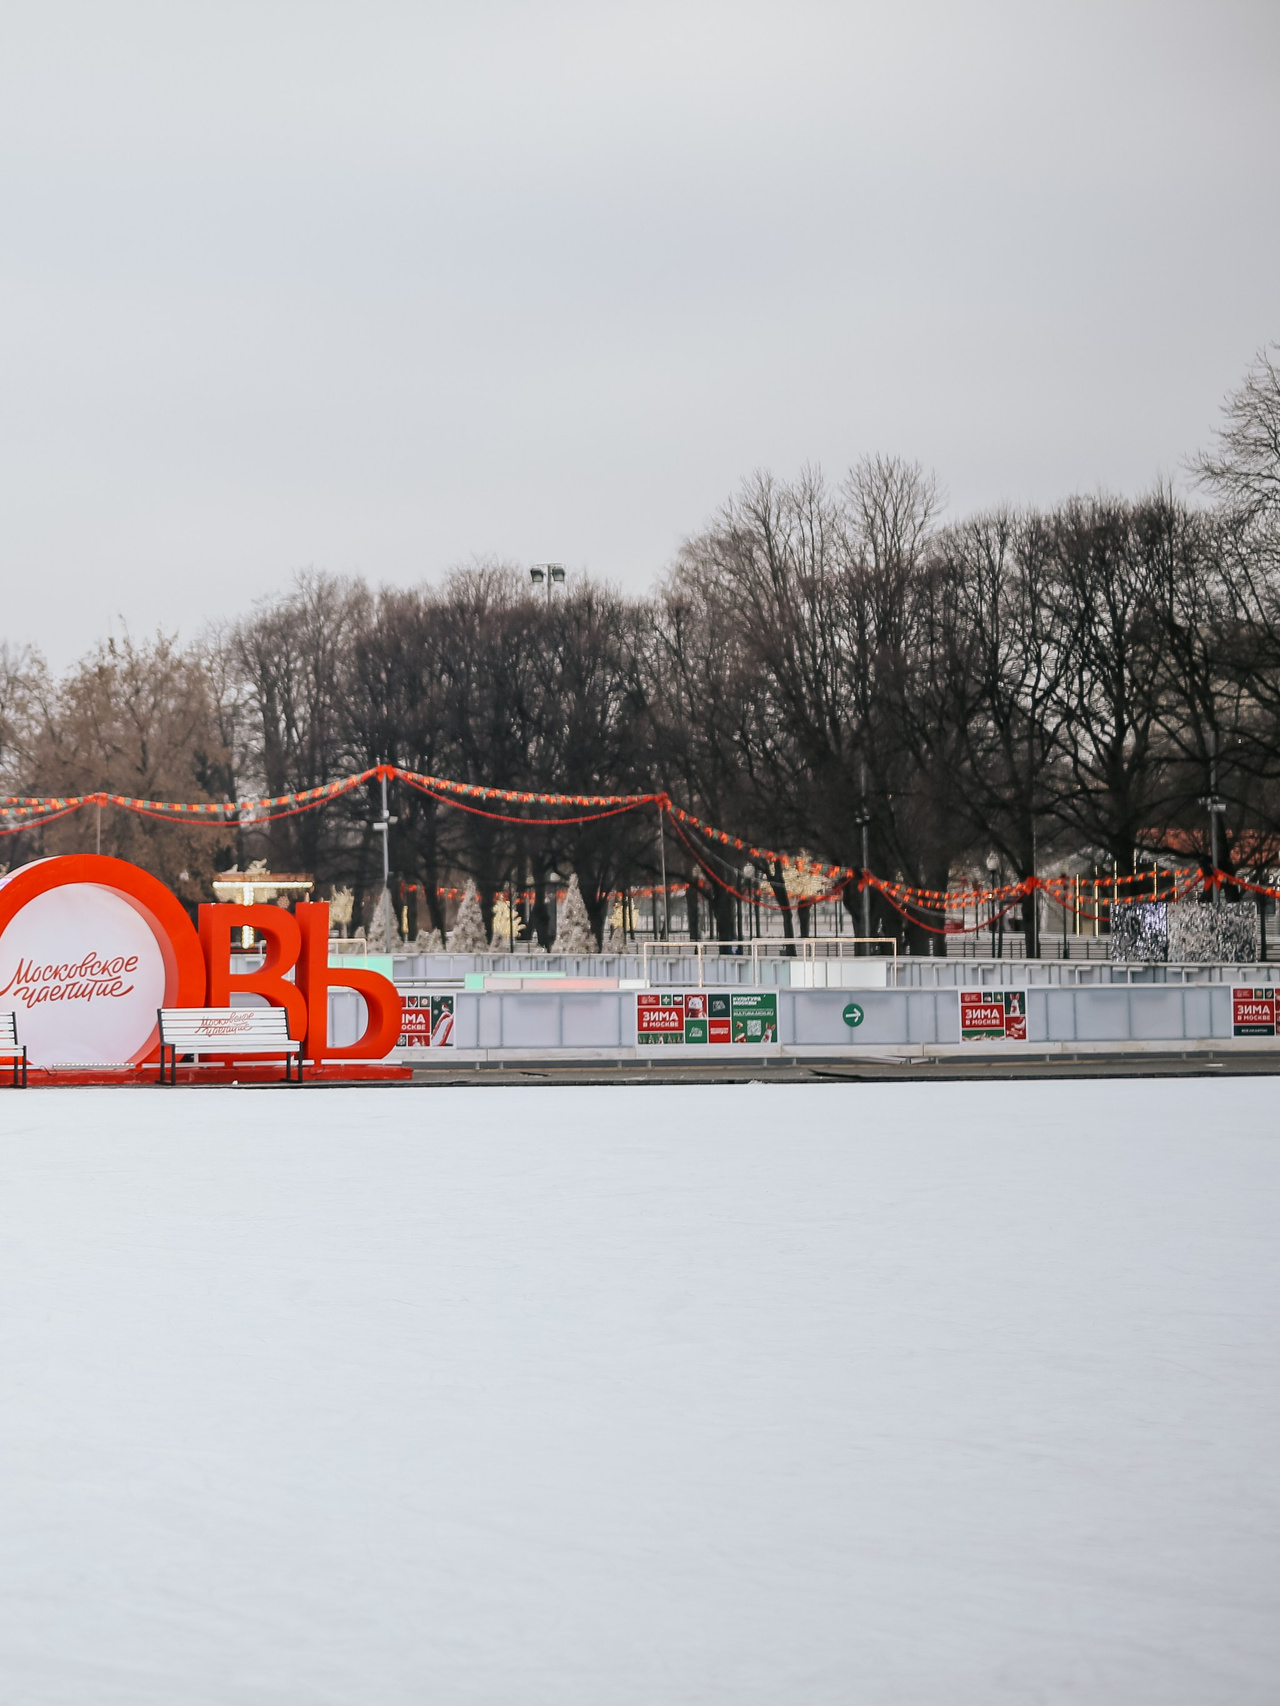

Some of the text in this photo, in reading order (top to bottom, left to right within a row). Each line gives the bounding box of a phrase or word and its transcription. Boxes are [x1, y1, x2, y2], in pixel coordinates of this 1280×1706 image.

[13, 975, 134, 1009] чаепитие
[965, 1009, 999, 1018] ЗИМА
[1237, 1005, 1270, 1014] ЗИМА
[642, 1011, 679, 1021] ЗИМА
